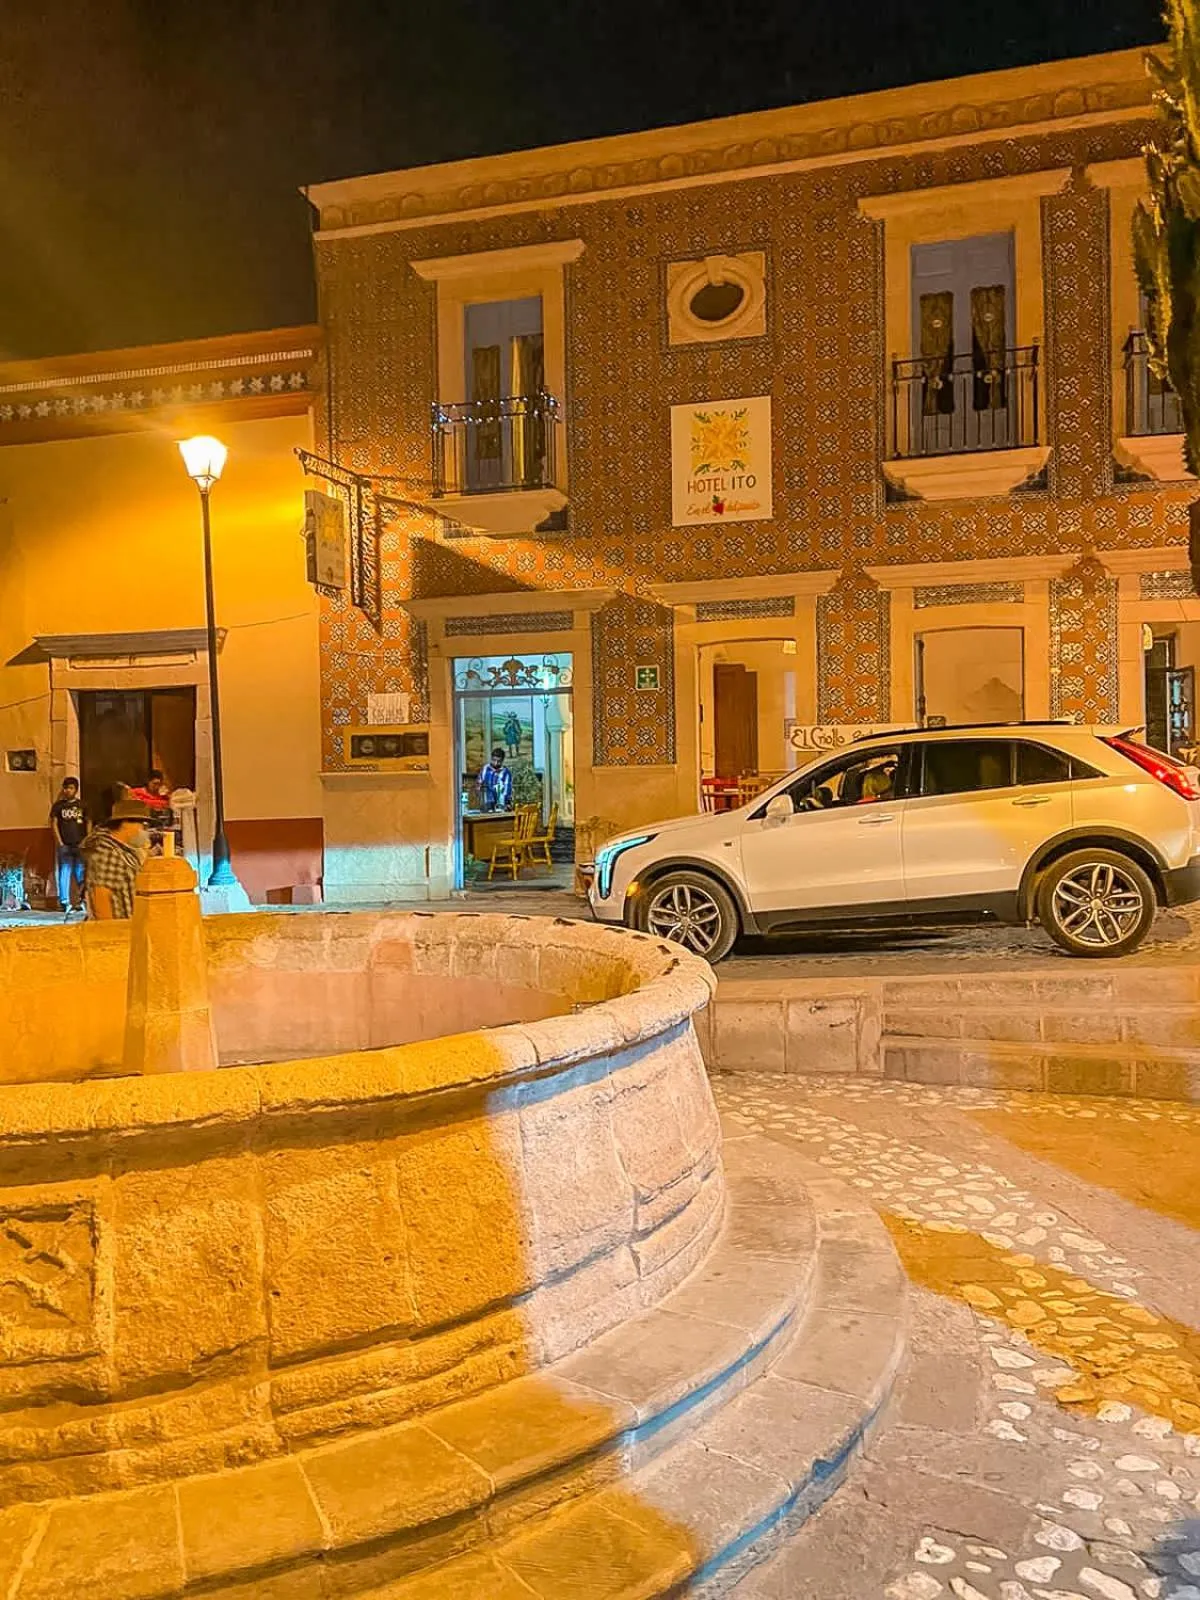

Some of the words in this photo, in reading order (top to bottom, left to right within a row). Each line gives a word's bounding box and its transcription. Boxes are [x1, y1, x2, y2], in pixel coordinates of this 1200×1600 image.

[687, 477, 726, 494] HOTEL
[732, 474, 757, 490] ITO
[810, 726, 846, 751] Criollo
